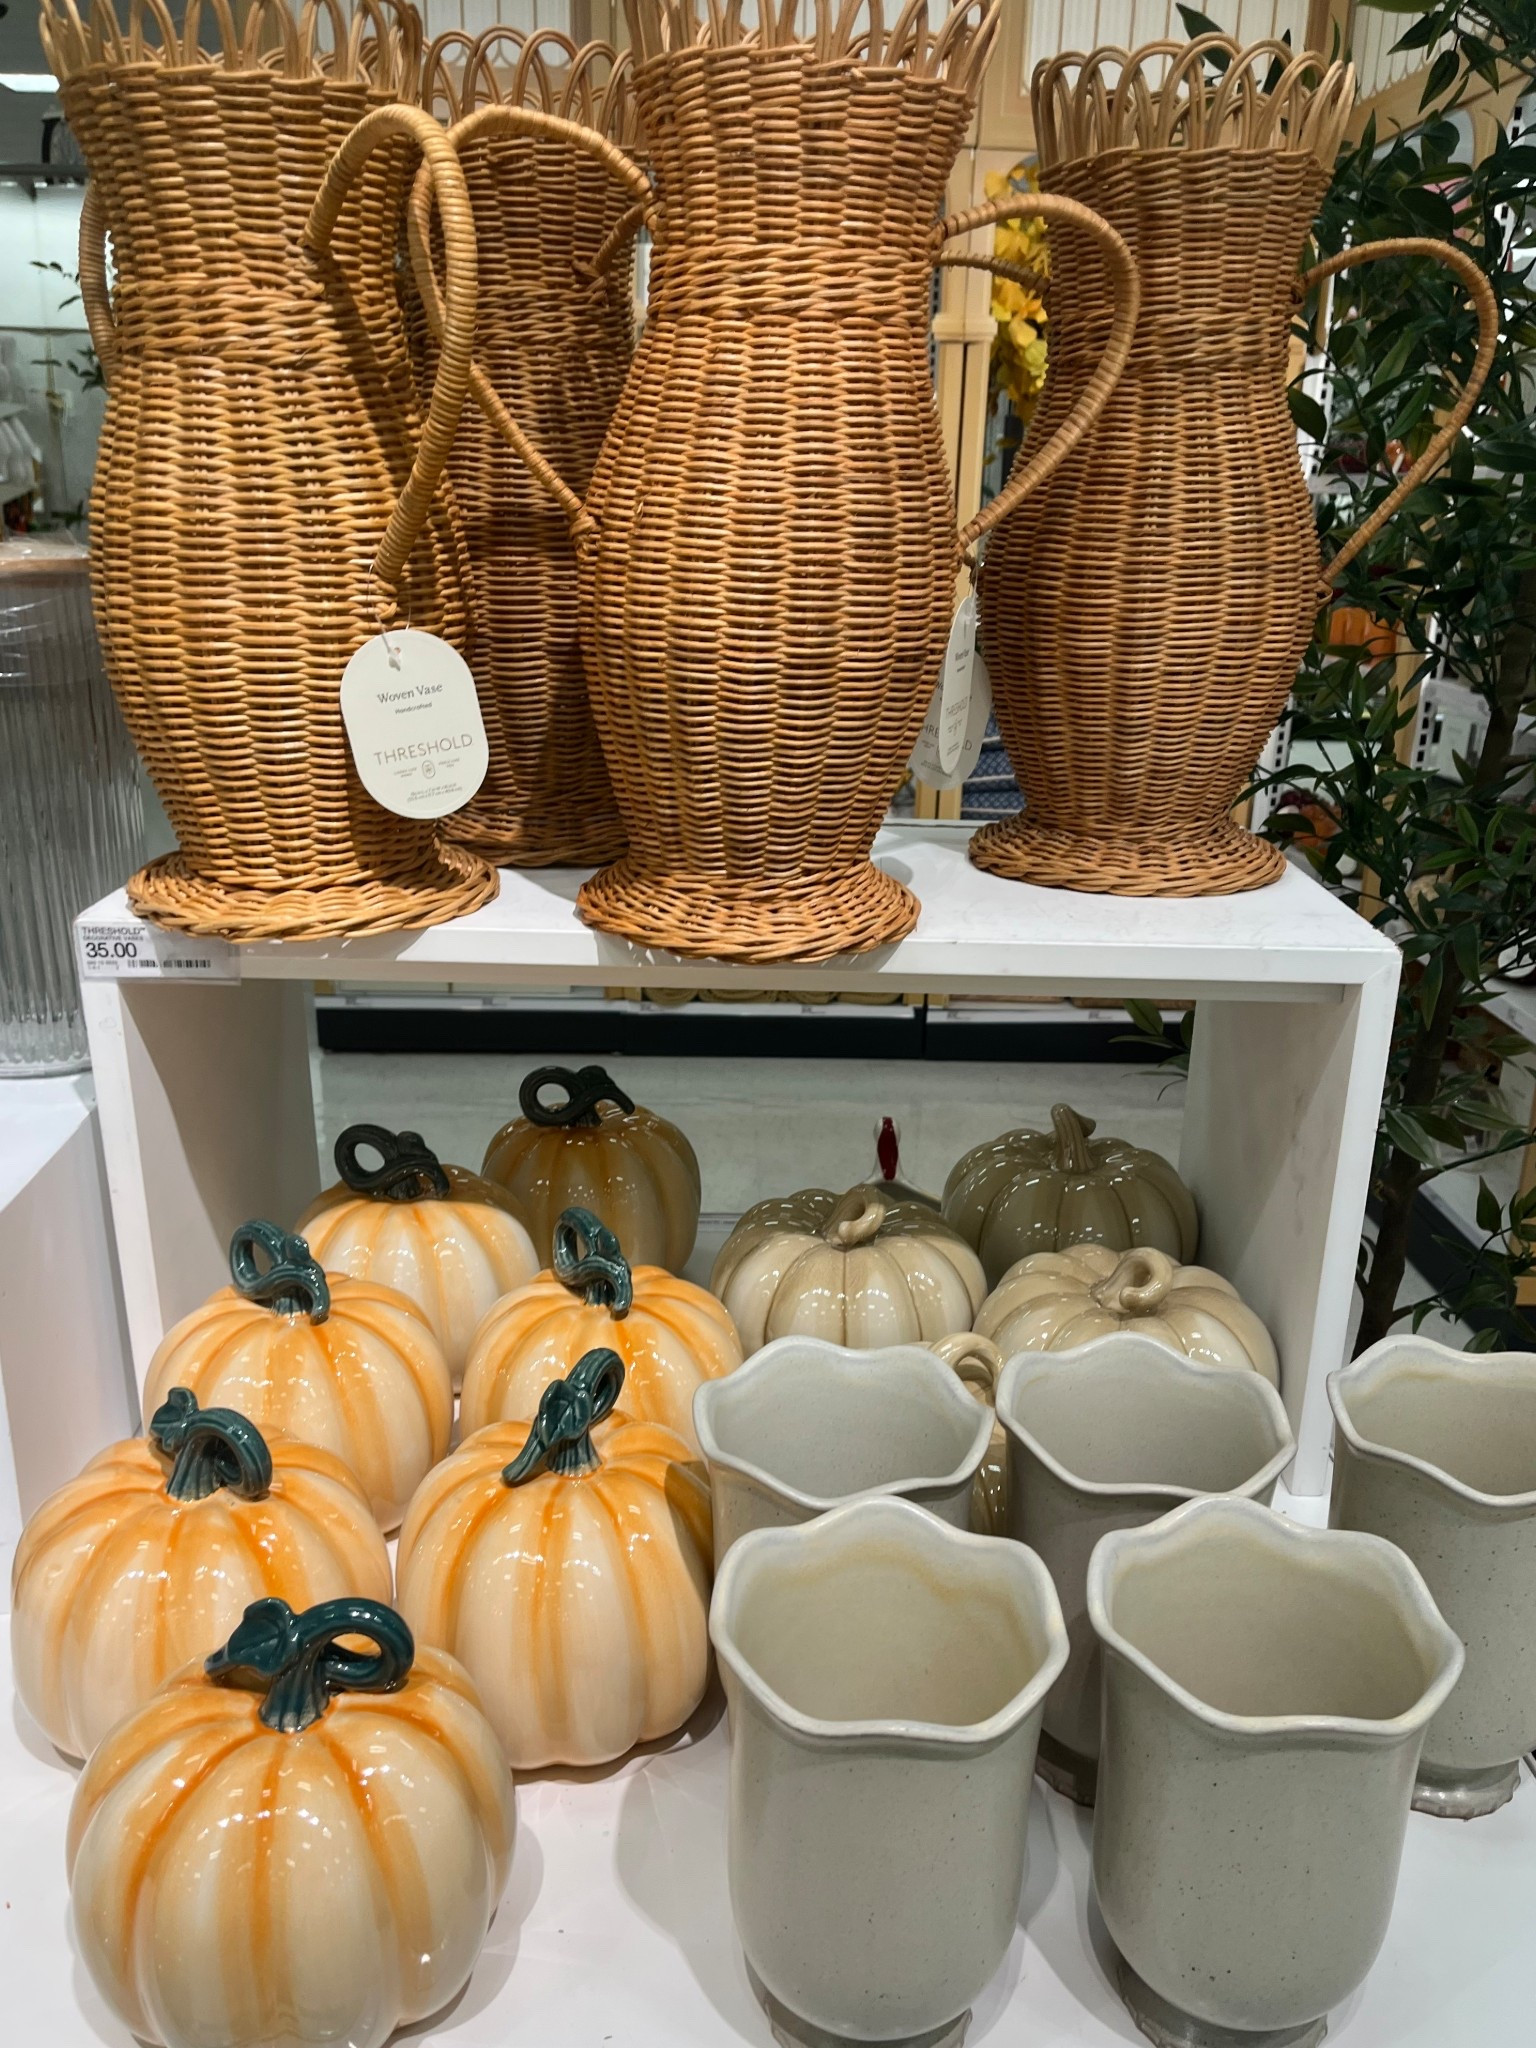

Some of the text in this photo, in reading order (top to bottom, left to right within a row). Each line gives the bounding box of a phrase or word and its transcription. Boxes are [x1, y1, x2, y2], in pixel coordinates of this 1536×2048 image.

[377, 684, 443, 703] Woven Vase
[374, 734, 473, 765] THRESHOLD
[86, 942, 137, 958] 35.00
